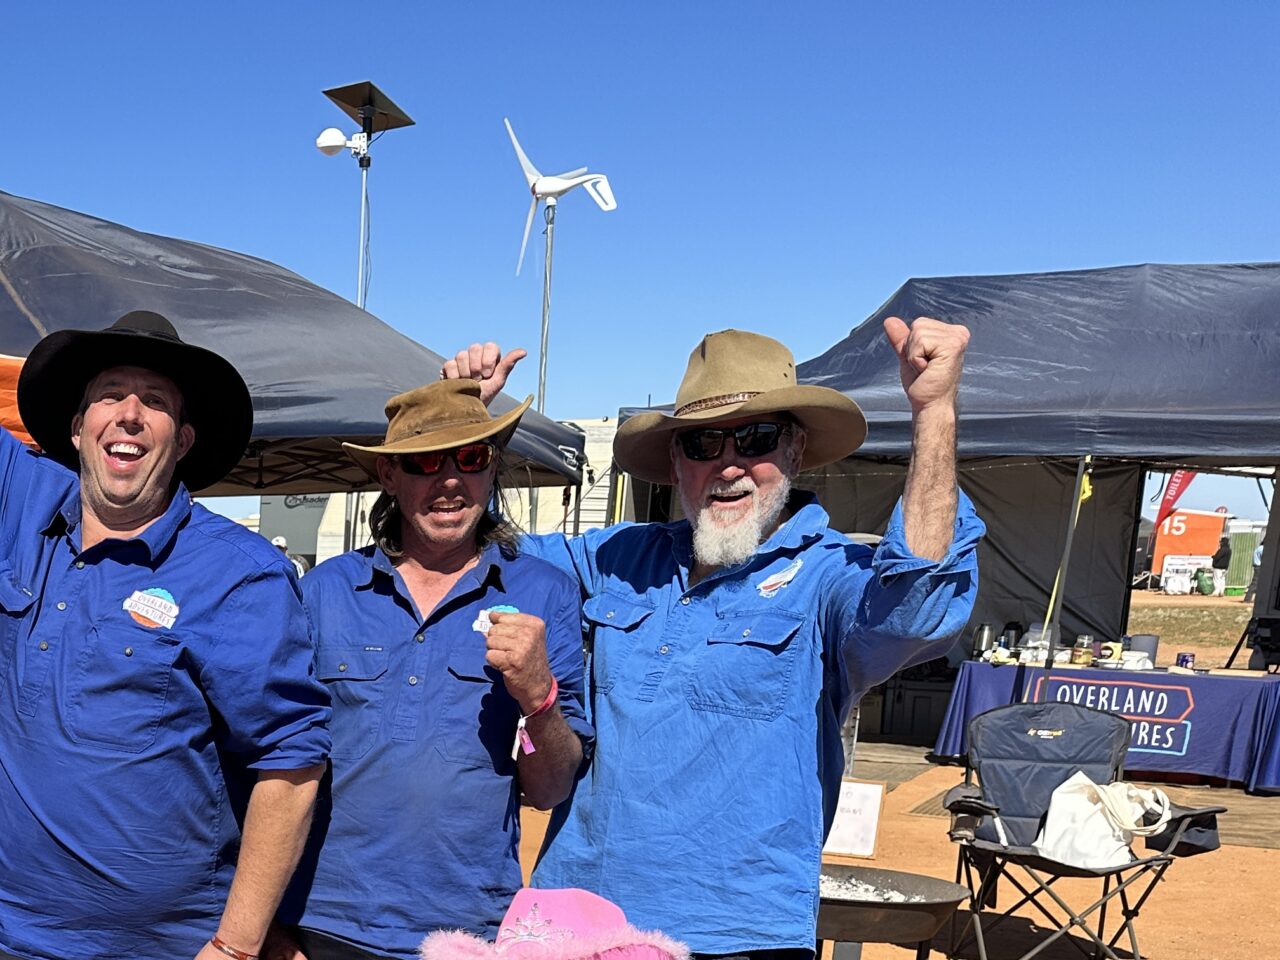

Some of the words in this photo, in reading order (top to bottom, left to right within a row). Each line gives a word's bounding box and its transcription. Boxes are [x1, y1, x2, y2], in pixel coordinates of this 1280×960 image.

[1166, 470, 1185, 500] TOILET
[1161, 516, 1187, 536] 15
[1056, 684, 1168, 716] OVERLAND
